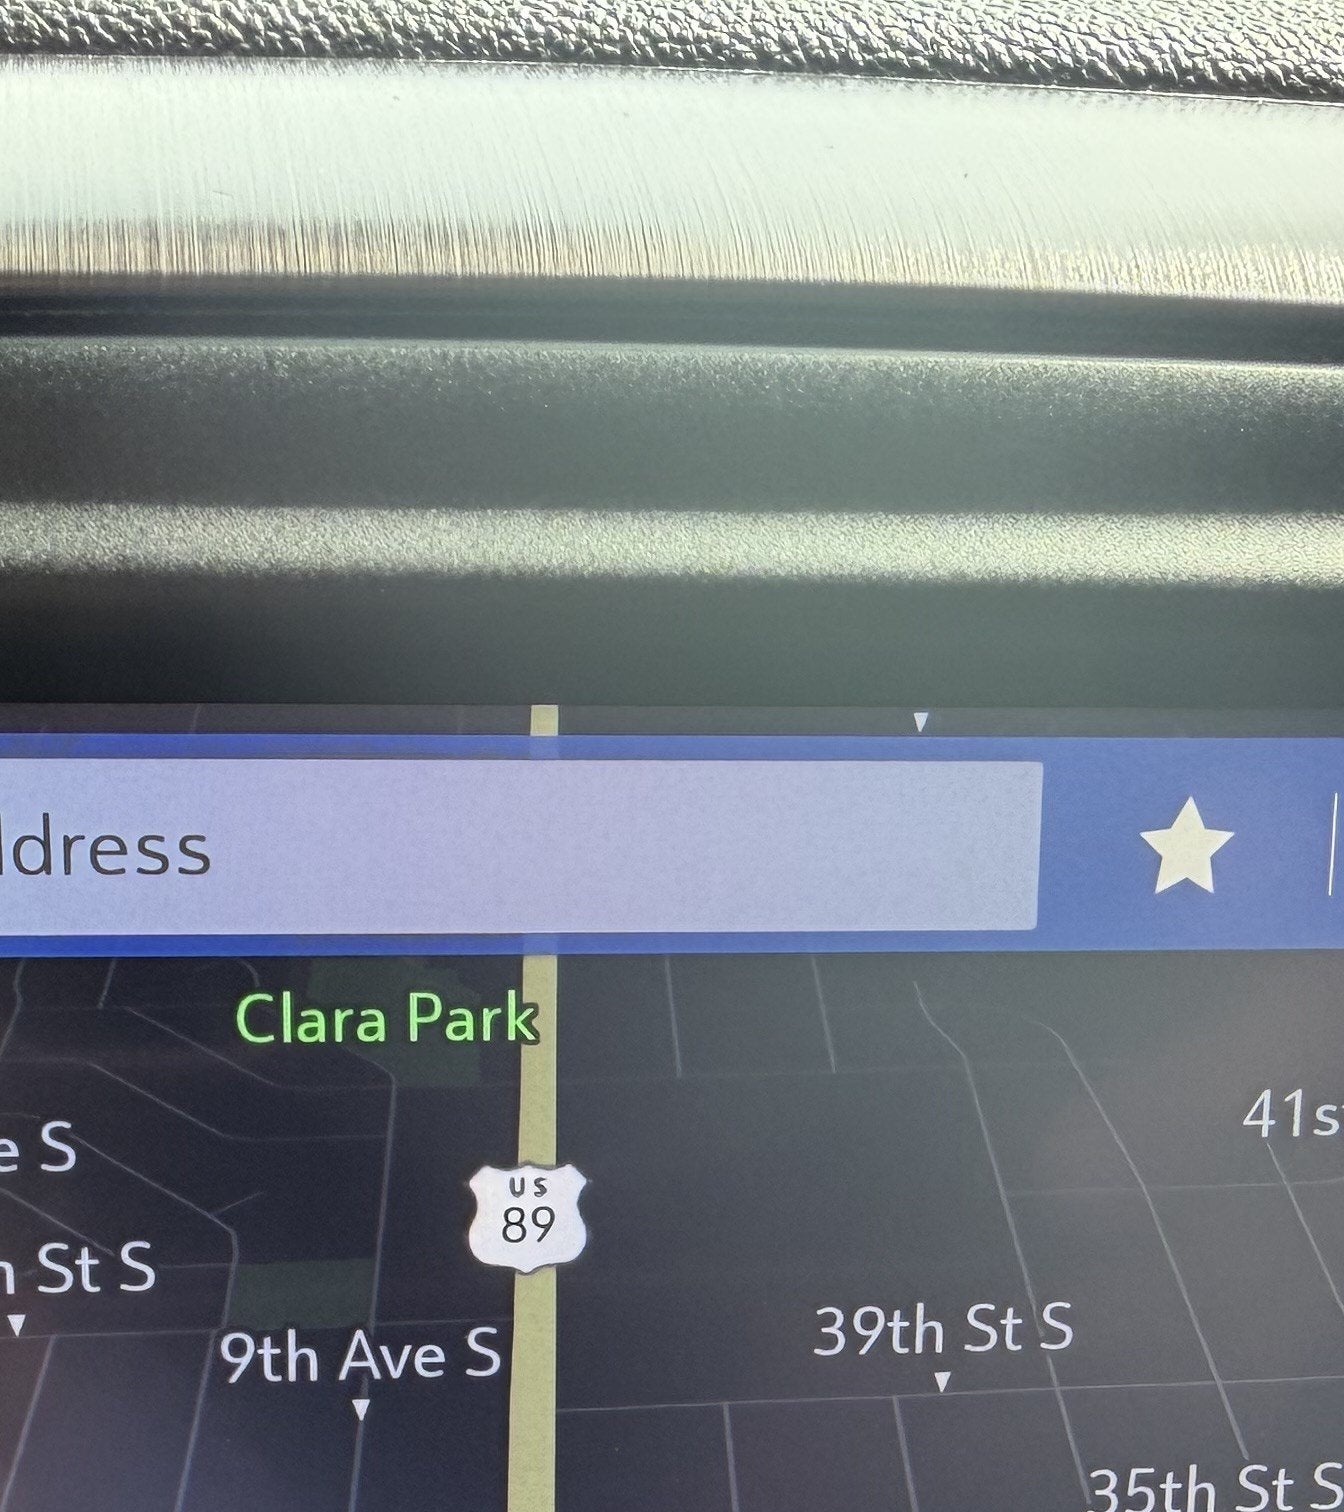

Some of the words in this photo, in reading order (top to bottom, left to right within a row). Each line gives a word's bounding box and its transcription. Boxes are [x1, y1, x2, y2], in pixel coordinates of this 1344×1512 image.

[235, 991, 388, 1045] Clara
[407, 990, 539, 1043] Park
[40, 1120, 77, 1172] S
[509, 1176, 548, 1199] US
[501, 1206, 556, 1244] 89
[37, 1242, 101, 1294] St
[119, 1240, 156, 1292] S
[220, 1328, 318, 1384] 9th
[338, 1329, 446, 1381] Ave
[465, 1326, 501, 1377] S
[813, 1302, 944, 1356] 39th
[964, 1303, 1023, 1352] St
[1039, 1301, 1073, 1350] S
[1235, 1464, 1295, 1512] St
[1310, 1461, 1344, 1510] S
